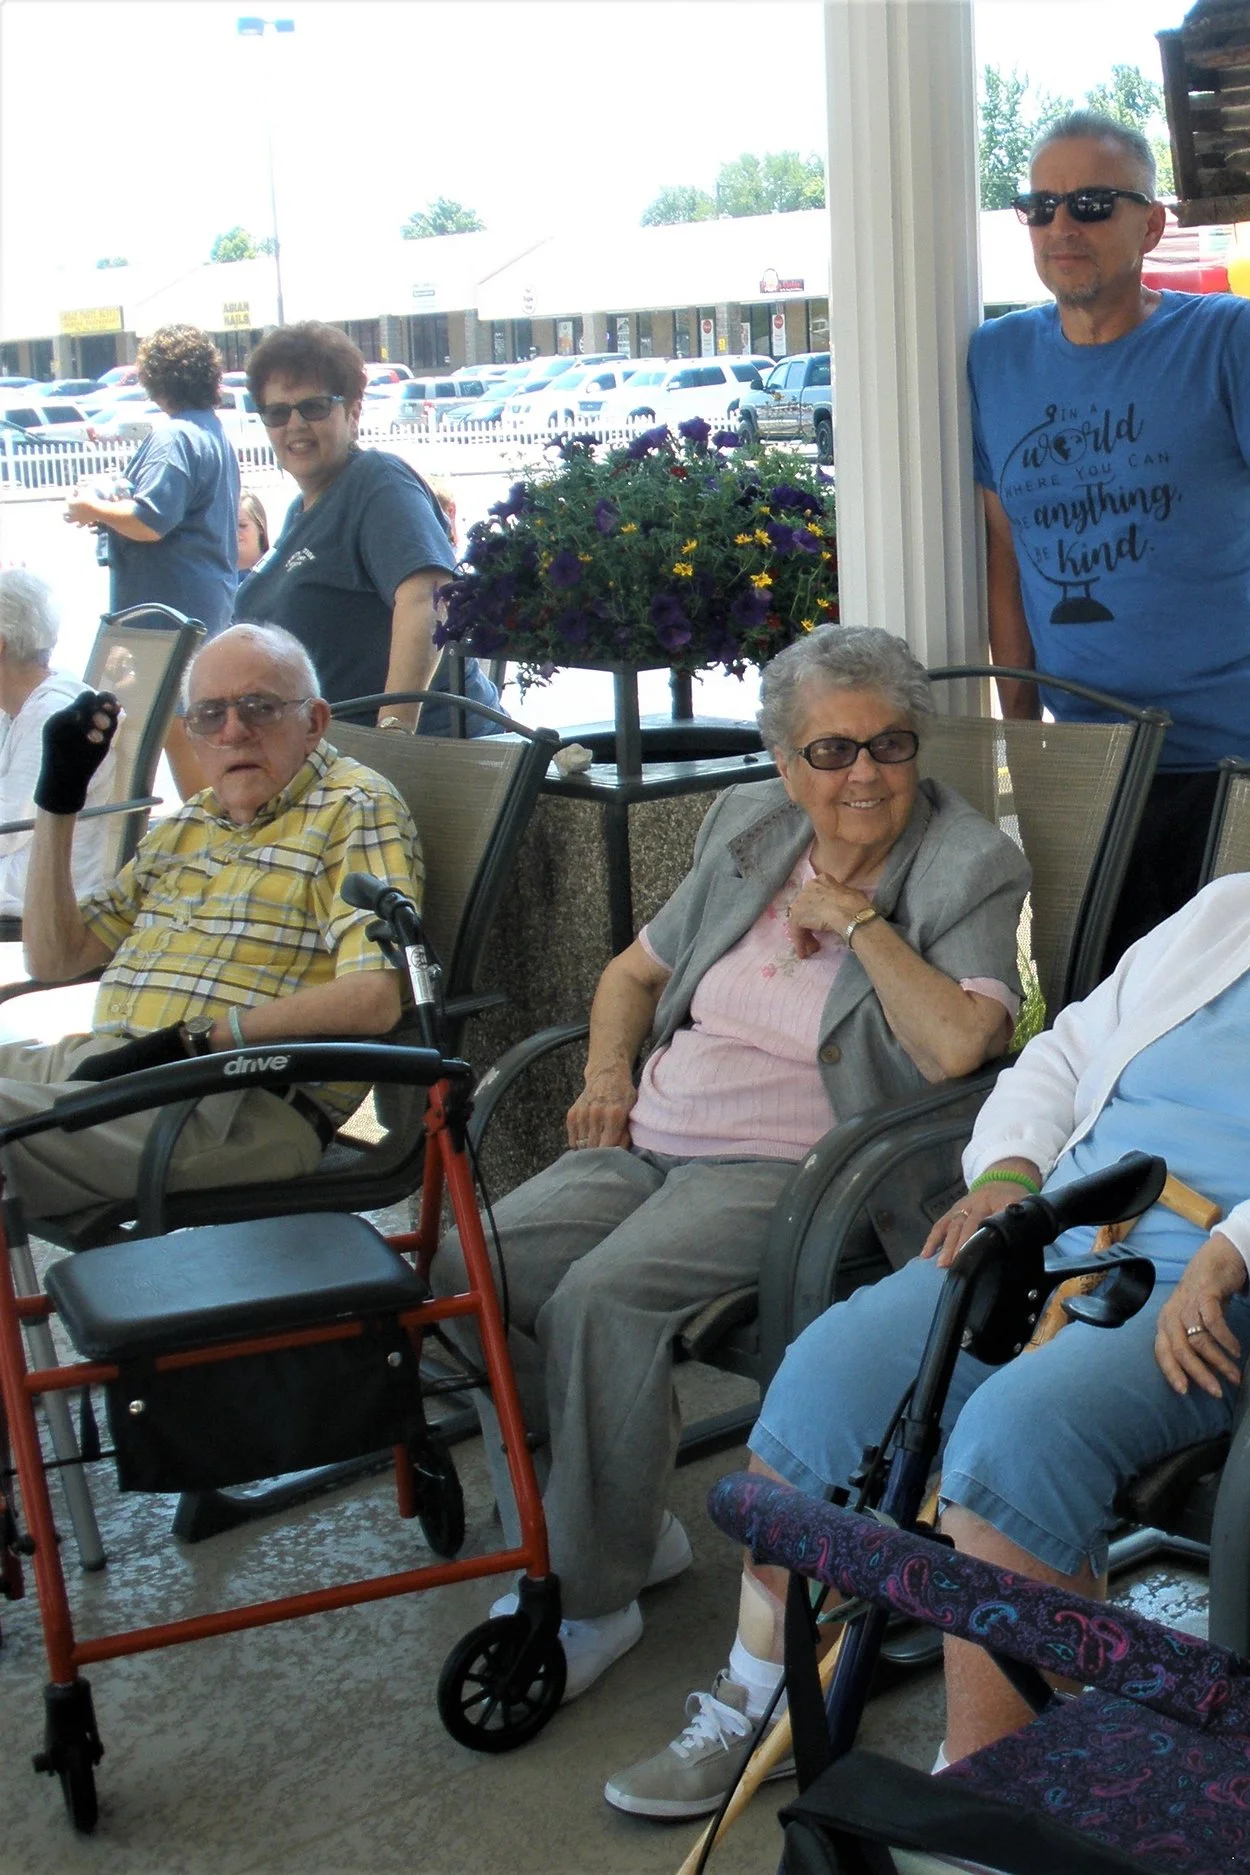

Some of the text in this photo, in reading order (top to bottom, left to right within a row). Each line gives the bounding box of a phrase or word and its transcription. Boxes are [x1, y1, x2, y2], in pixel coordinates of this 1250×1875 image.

[1061, 404, 1098, 421] IN A
[1023, 403, 1144, 468] world
[1006, 453, 1169, 498] WHERE YOU CAN
[1035, 547, 1049, 562] BE
[223, 1055, 290, 1076] drive
